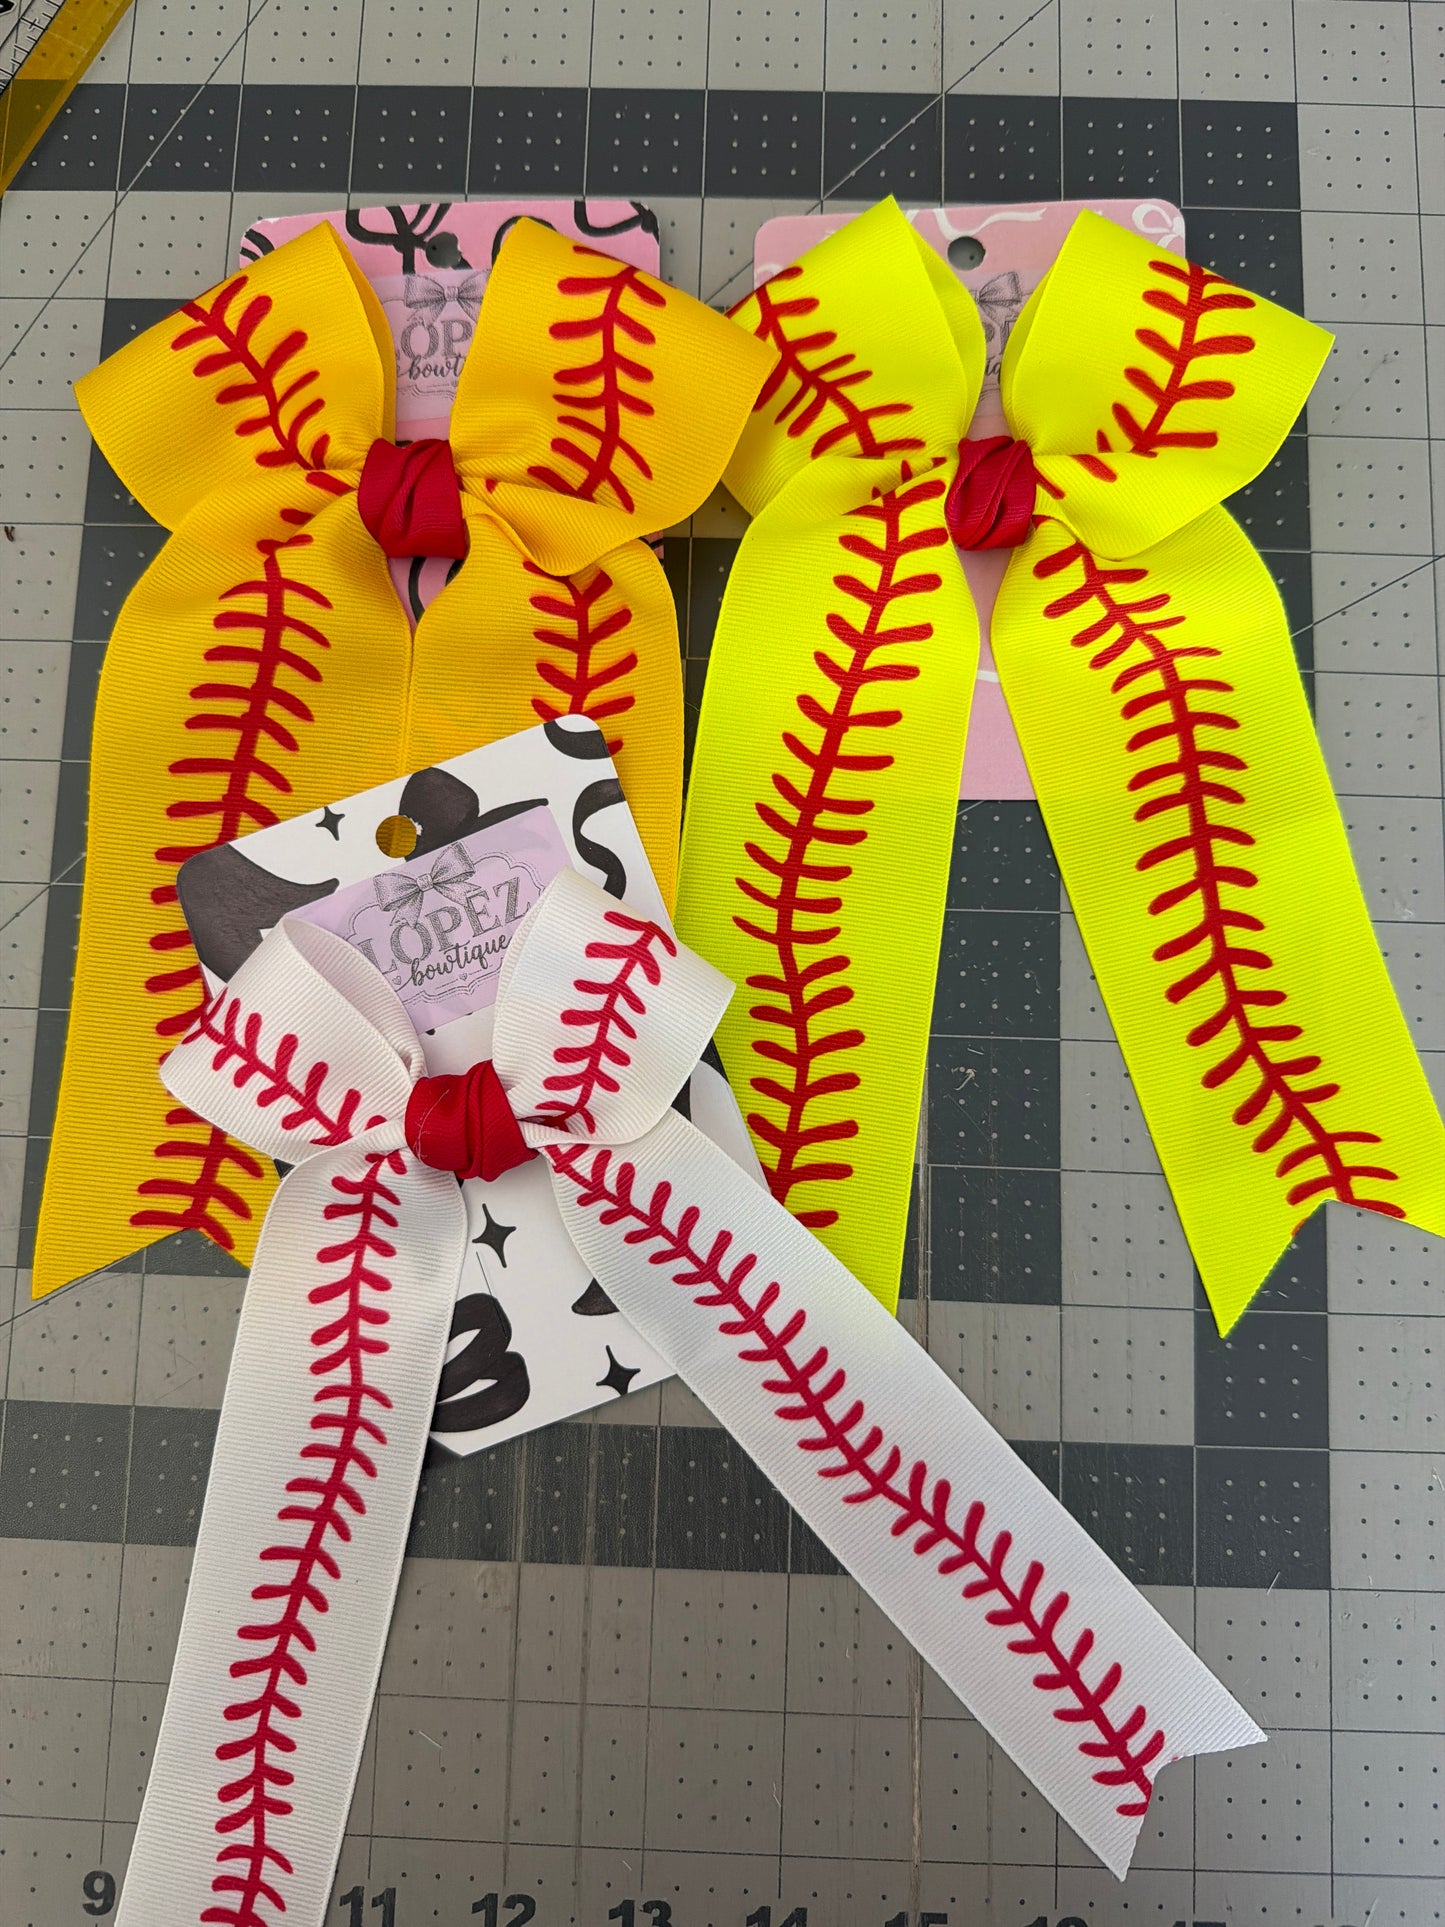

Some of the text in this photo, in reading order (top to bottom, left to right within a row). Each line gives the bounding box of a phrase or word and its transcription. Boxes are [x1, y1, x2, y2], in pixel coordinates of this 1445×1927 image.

[357, 876, 531, 974] LOPEZ
[402, 933, 512, 988] bowtique
[82, 1870, 116, 1915] 9
[339, 1885, 397, 1927] 11
[471, 1893, 537, 1927] 12
